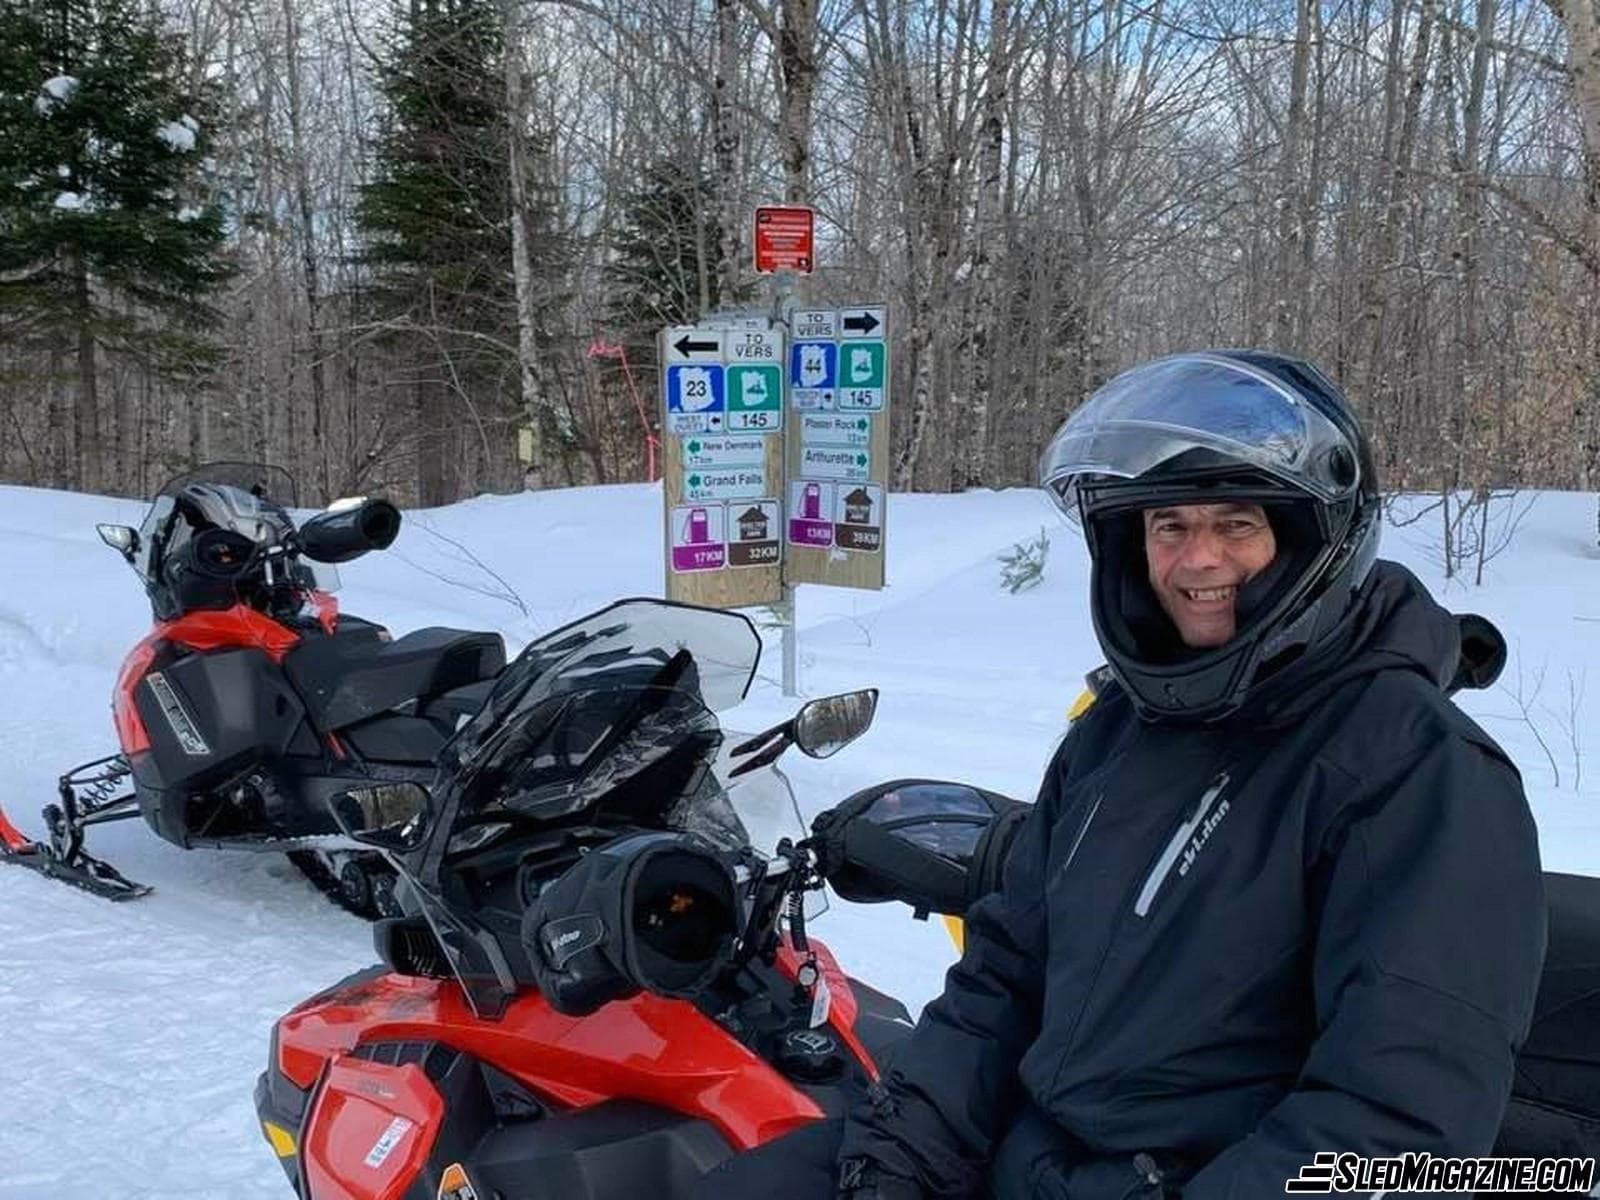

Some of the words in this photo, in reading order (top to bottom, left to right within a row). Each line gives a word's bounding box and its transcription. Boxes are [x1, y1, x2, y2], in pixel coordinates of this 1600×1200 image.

[806, 313, 824, 323] TO
[745, 333, 763, 344] TO
[735, 345, 773, 358] VERS
[805, 359, 821, 374] 44
[686, 380, 707, 397] 23
[850, 390, 873, 406] 145
[741, 412, 768, 428] 145
[703, 441, 722, 450] New
[724, 440, 763, 451] Denmark
[805, 449, 855, 465] Arthurette
[703, 474, 736, 487] Grand
[738, 473, 763, 485] Falls
